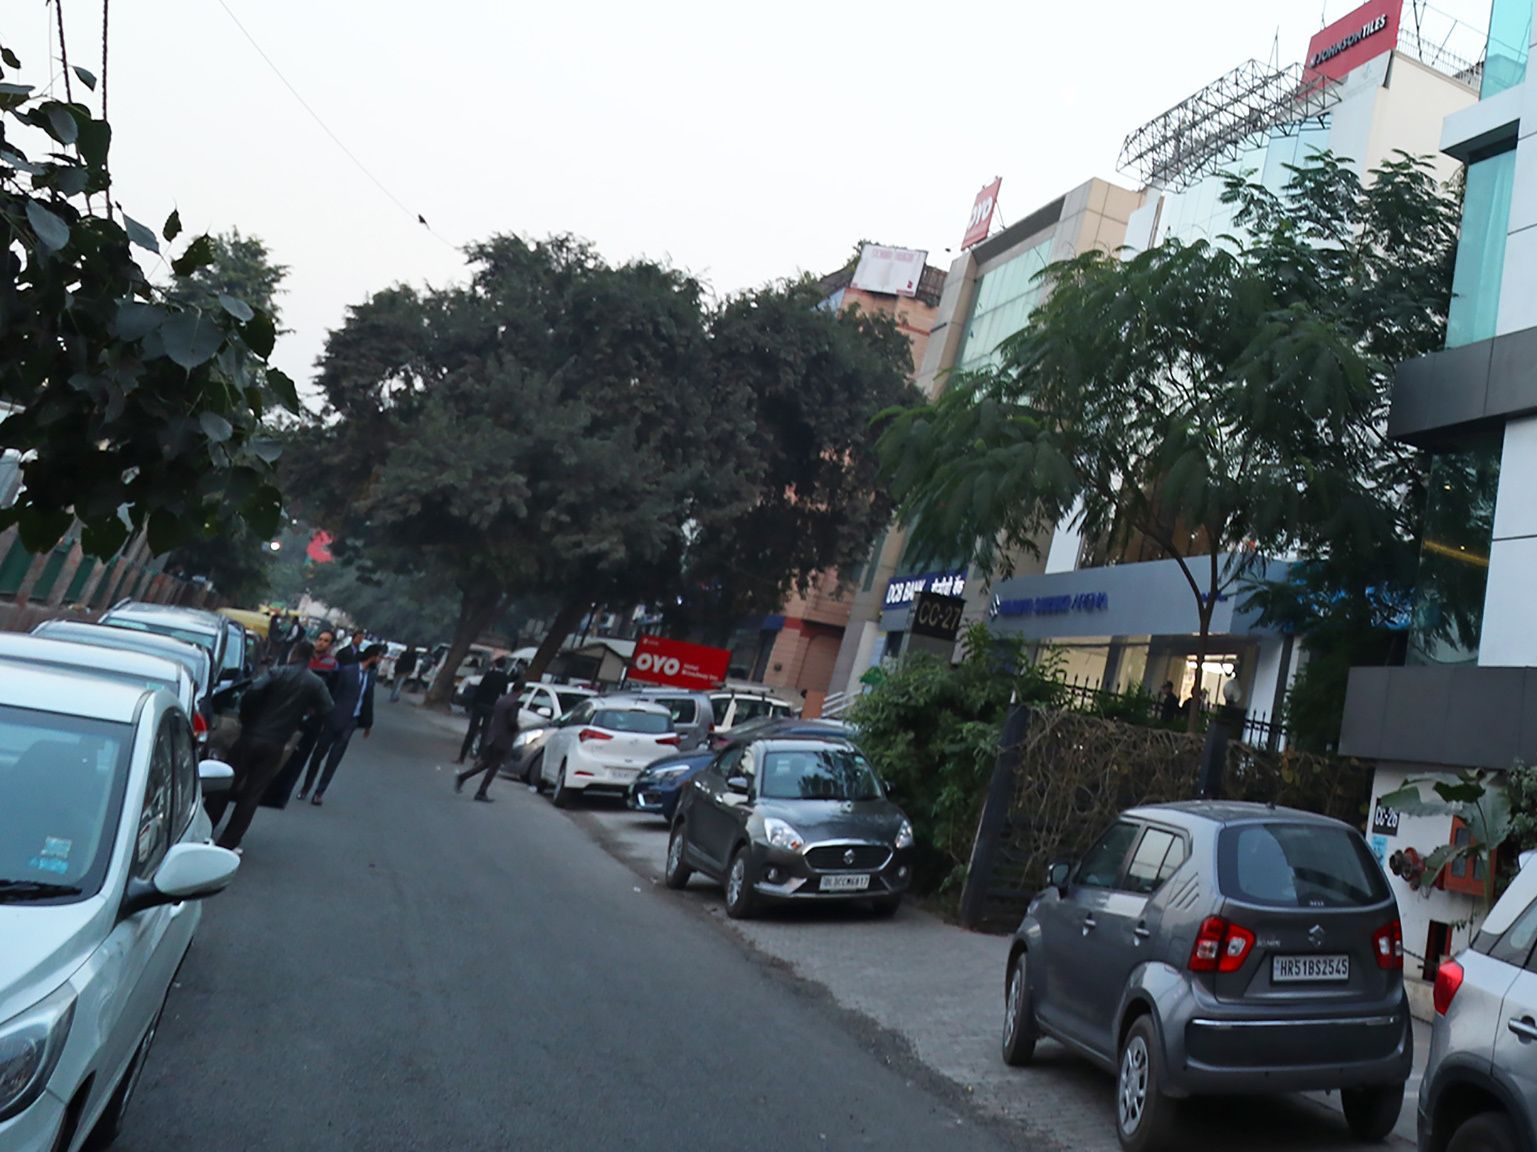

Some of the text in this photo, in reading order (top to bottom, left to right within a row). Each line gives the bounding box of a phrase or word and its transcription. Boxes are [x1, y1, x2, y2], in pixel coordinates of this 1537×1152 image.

[919, 601, 961, 630] CC-27
[636, 652, 680, 677] OYO
[1280, 958, 1348, 977] HR51BS2545
